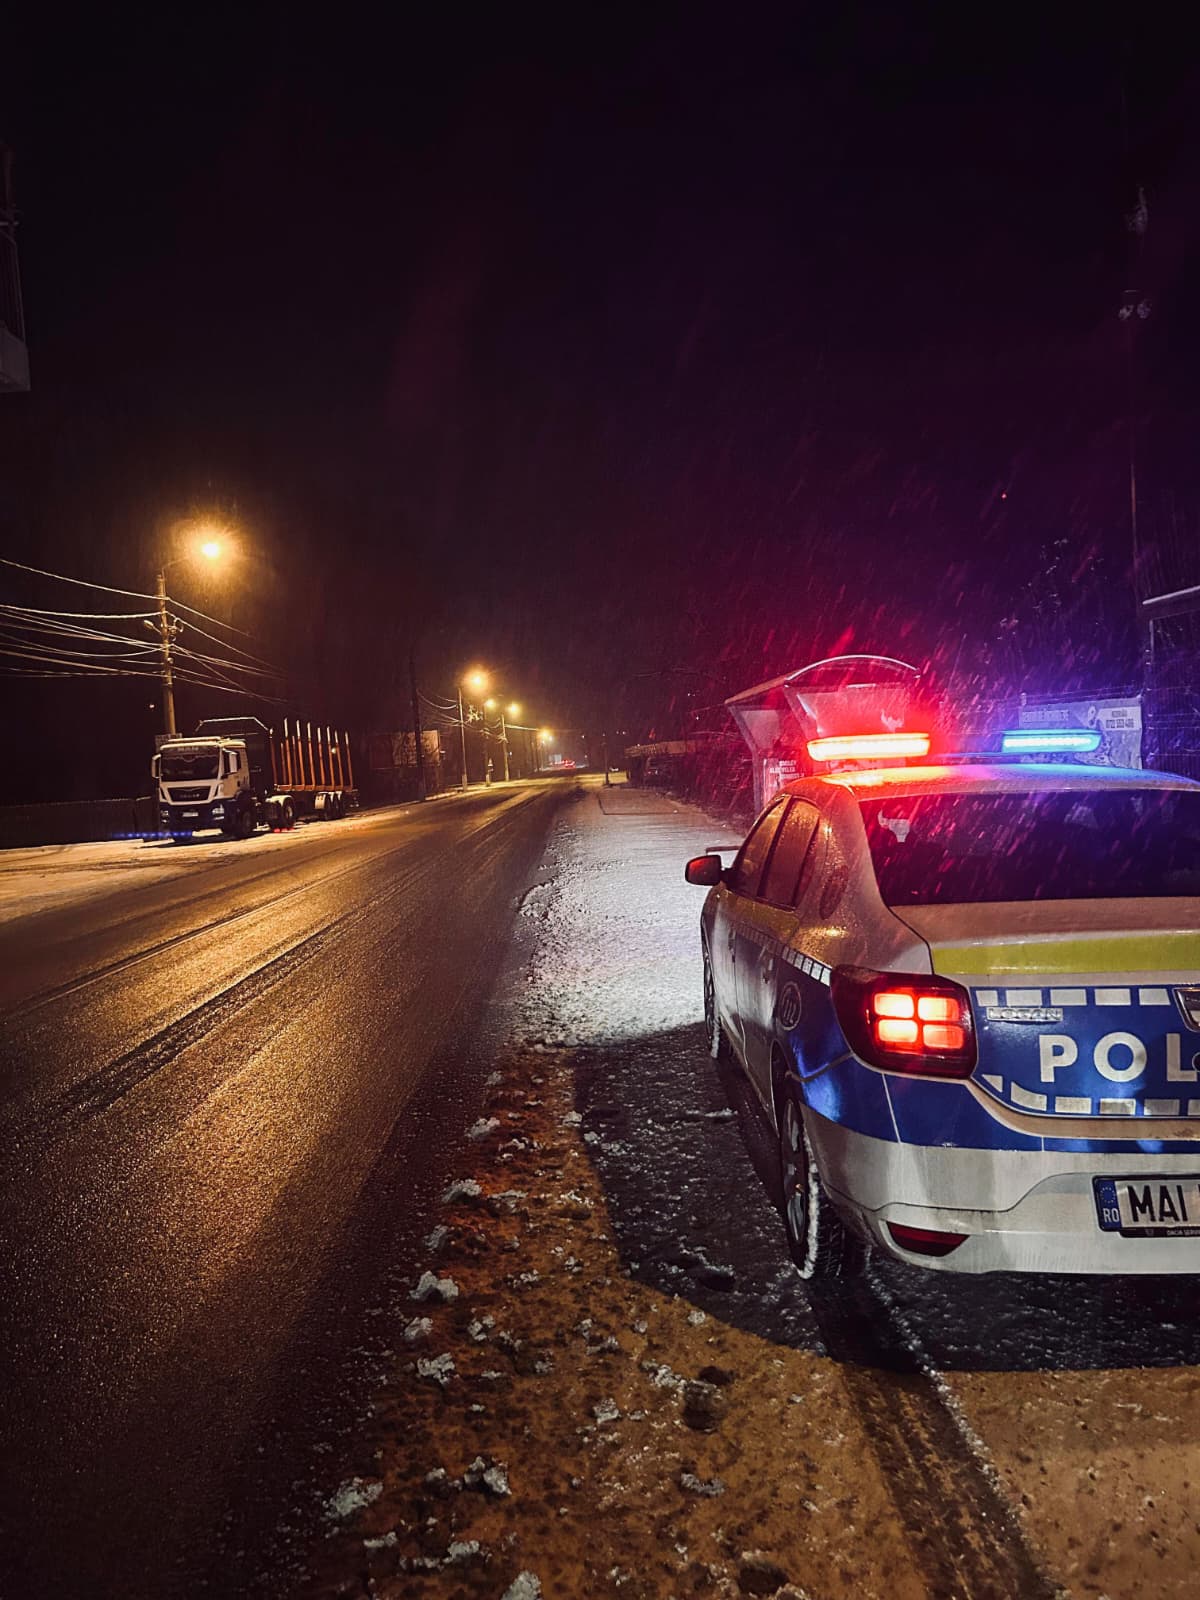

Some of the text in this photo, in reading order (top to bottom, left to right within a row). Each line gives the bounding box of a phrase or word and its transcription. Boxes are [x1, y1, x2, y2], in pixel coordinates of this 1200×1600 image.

[988, 1008, 1062, 1020] LOGAN
[1039, 1031, 1198, 1083] POL
[1103, 1185, 1188, 1222] RO MAI
